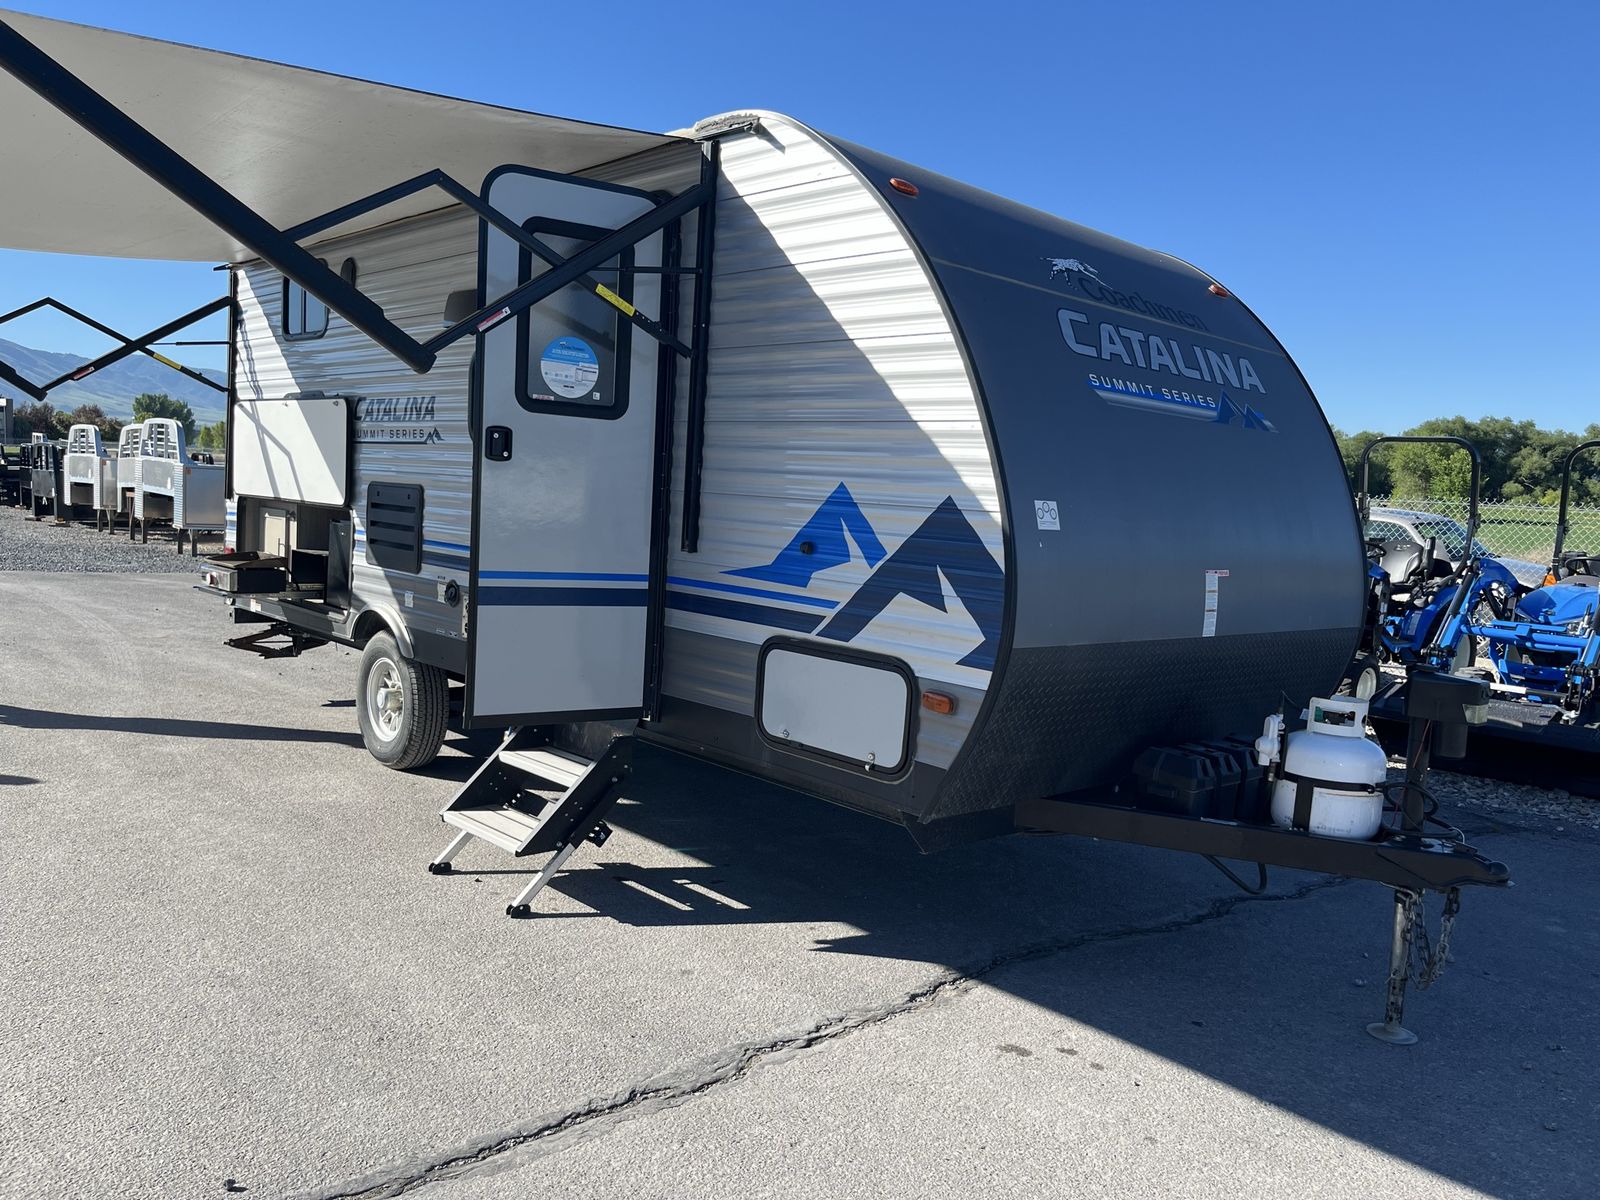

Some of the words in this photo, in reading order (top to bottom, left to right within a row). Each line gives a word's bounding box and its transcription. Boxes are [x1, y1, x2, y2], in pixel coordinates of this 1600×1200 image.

[1078, 277, 1208, 331] Coachmen
[1056, 308, 1268, 395] CATALINA
[354, 396, 436, 422] CATALINA
[1088, 373, 1154, 398] SUMMIT
[1164, 388, 1216, 409] SERIES
[357, 429, 385, 438] UMMIT
[389, 429, 425, 439] SERIES
